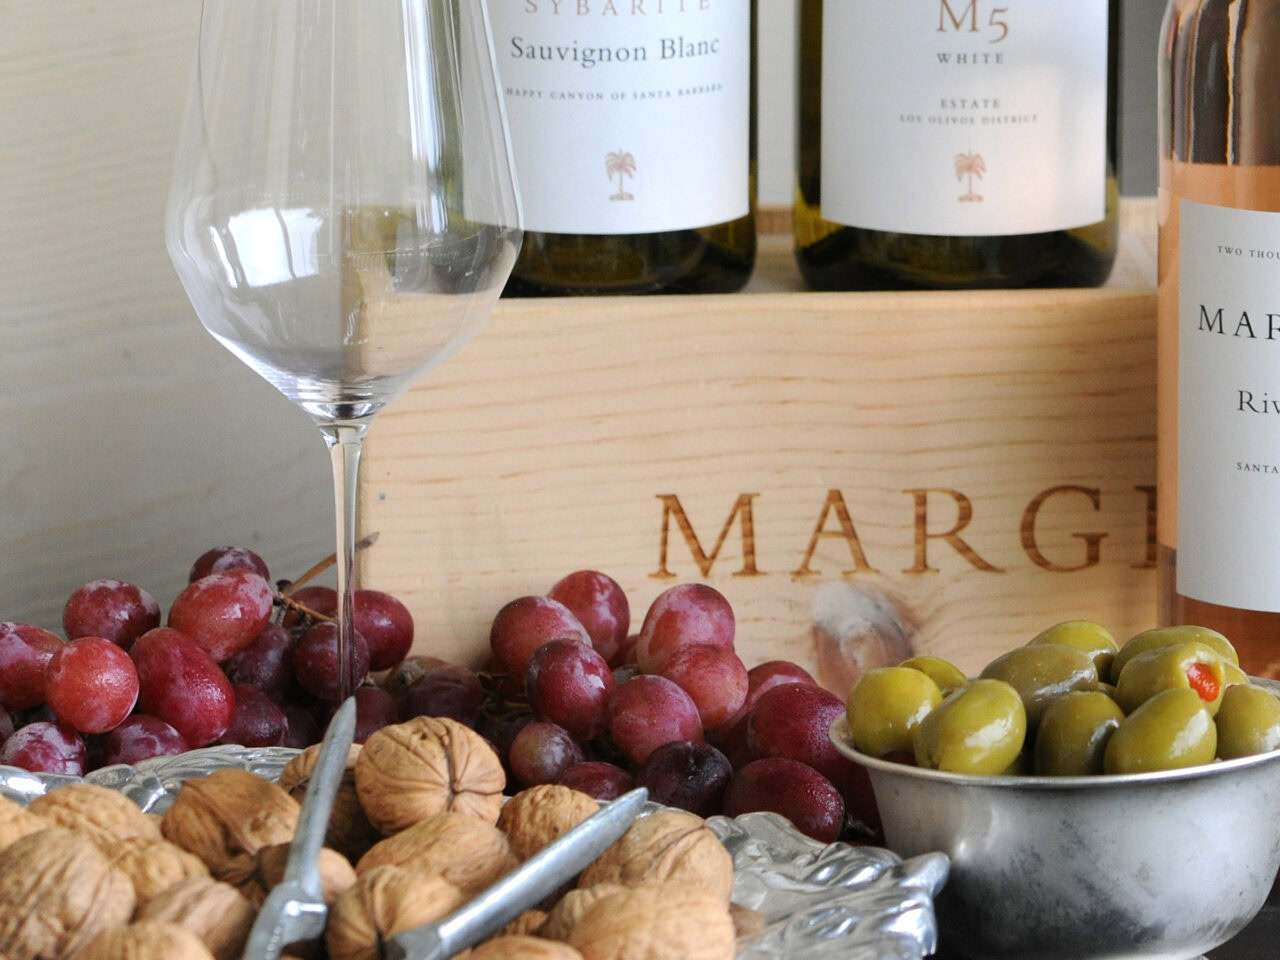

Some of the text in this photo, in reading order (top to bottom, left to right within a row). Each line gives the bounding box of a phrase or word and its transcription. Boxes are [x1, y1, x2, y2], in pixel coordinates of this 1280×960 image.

[510, 35, 720, 69] Sauvignon Blanc
[935, 51, 1004, 65] WHITE
[504, 86, 543, 99] HAPPY
[549, 90, 604, 101] CANYON
[609, 91, 627, 101] OF
[631, 89, 672, 101] SANTA
[940, 98, 1000, 110] ESTATE
[899, 113, 1038, 126] LOS OLIVOS DISTRICT
[1216, 245, 1243, 257] TWO
[1236, 461, 1280, 475] SANTA
